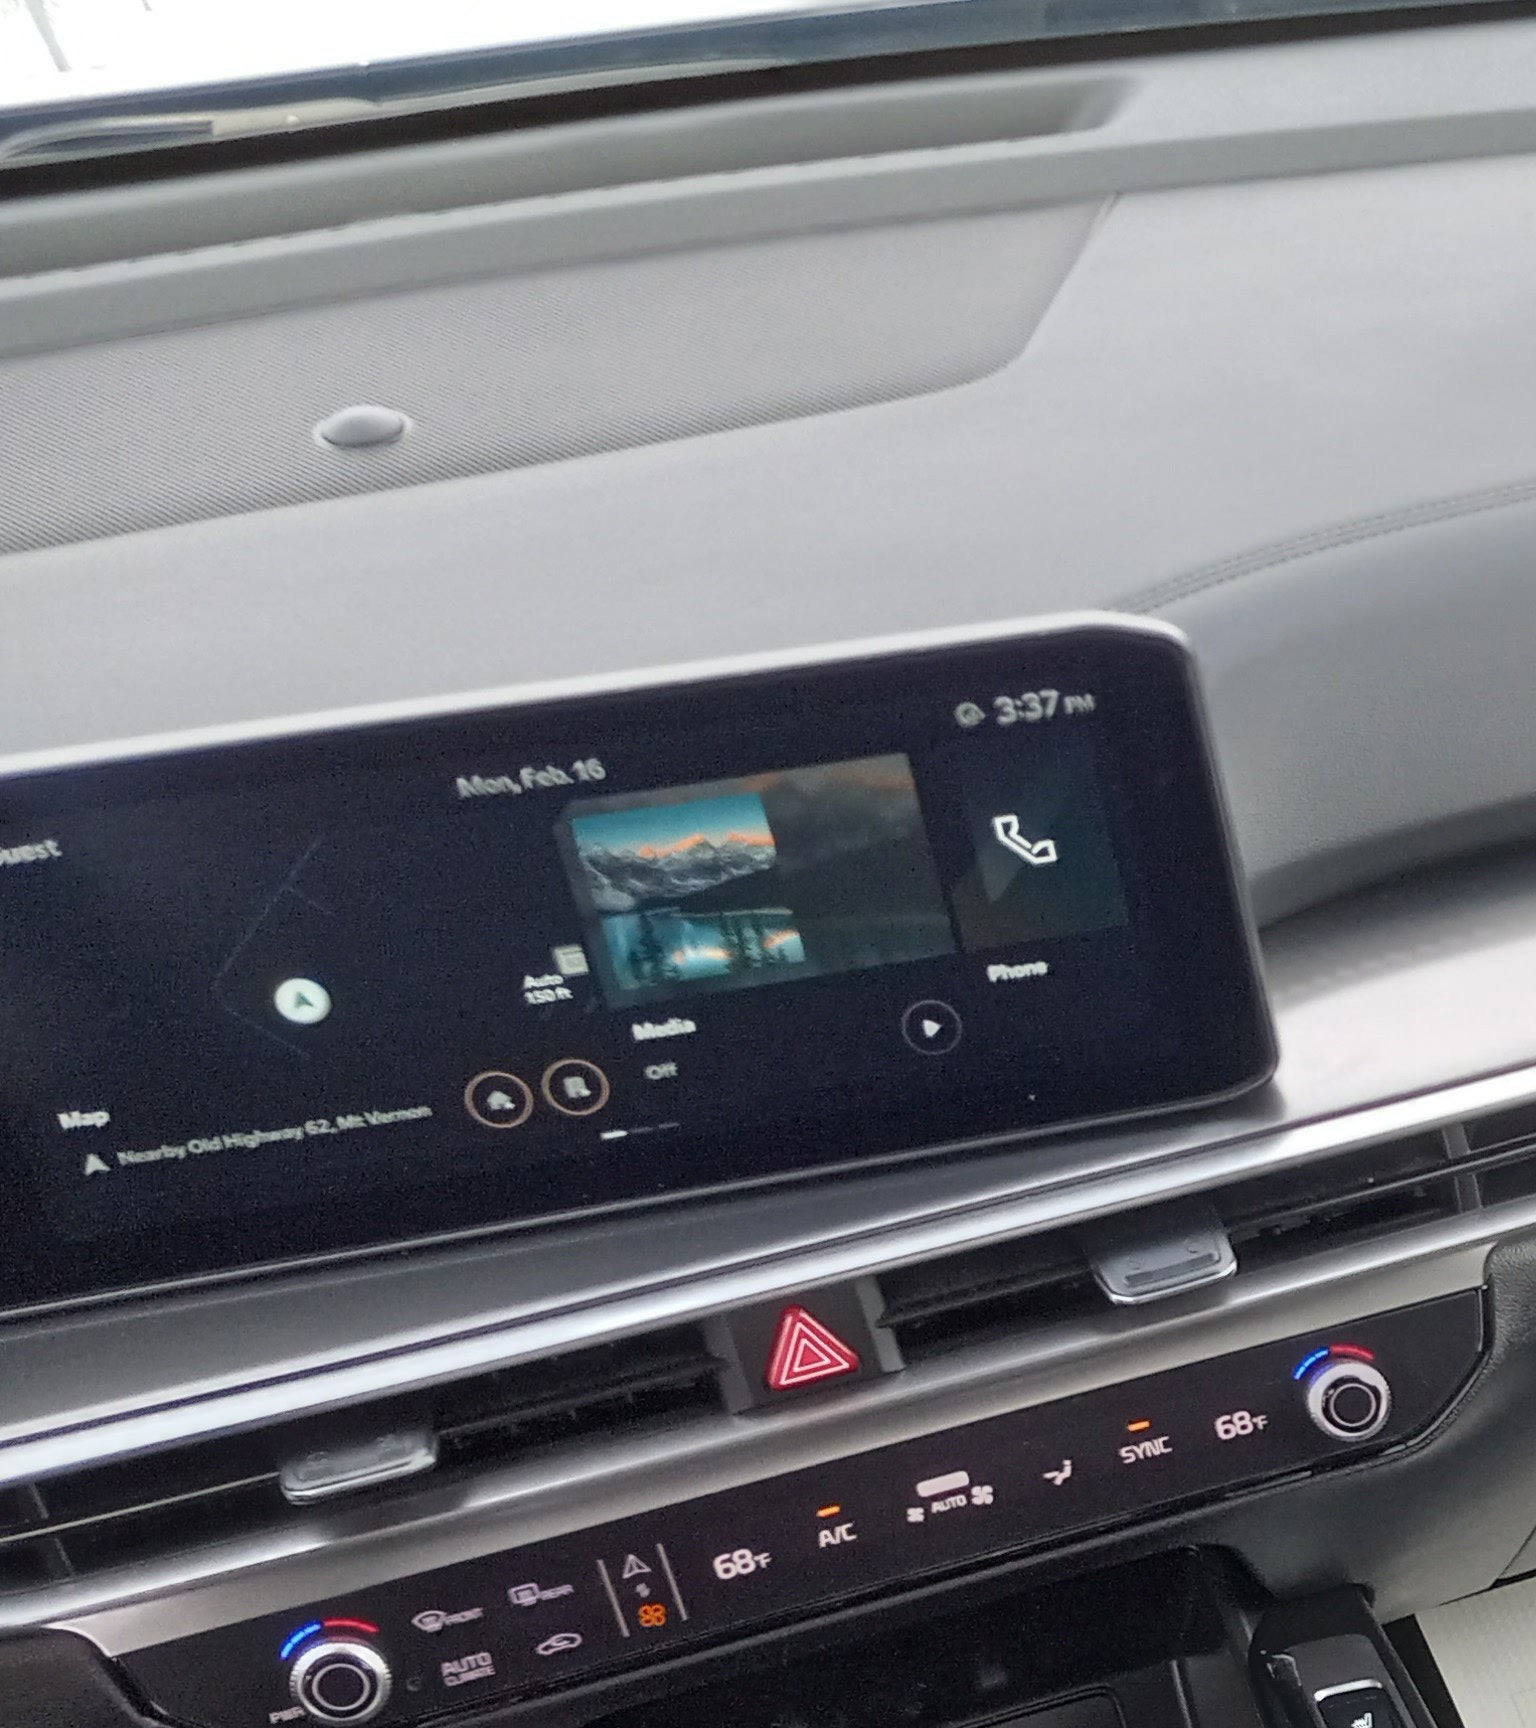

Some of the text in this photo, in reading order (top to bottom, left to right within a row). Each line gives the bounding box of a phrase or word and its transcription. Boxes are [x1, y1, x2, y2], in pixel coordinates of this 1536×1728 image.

[993, 689, 1096, 725] 3:37 PM
[572, 757, 606, 781] 16
[0, 839, 63, 867] uest
[987, 959, 1049, 983] Phone
[632, 1018, 697, 1041] Media
[645, 1061, 678, 1080] Off
[57, 1109, 111, 1132] Map
[187, 1135, 222, 1154] Old
[1118, 1435, 1173, 1464] SYNC
[931, 1494, 967, 1514] AUTO
[818, 1521, 857, 1548] A/C
[441, 1651, 492, 1678] AUTO
